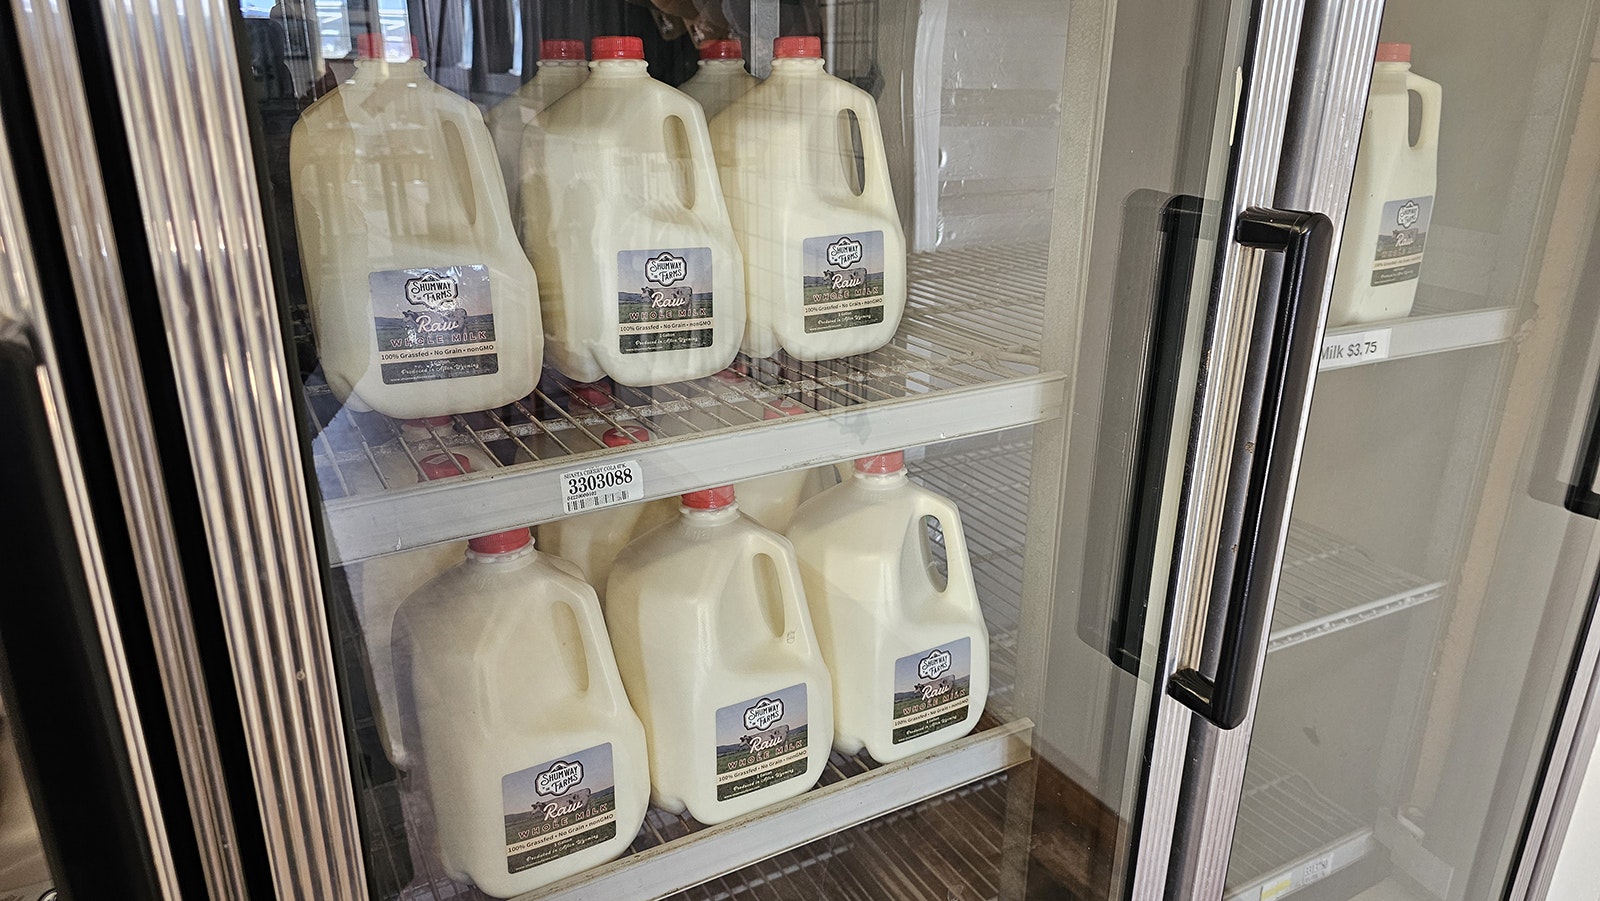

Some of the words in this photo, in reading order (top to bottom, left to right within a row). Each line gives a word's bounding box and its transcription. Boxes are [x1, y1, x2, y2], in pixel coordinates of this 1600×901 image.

[831, 246, 858, 256] SHUMWAY
[838, 252, 858, 264] FARMS
[650, 261, 682, 272] SHUMWAY
[658, 270, 682, 282] FARMS
[832, 274, 860, 289] Raw
[411, 282, 451, 294] SHUMWAY
[813, 291, 850, 301] WHOLE
[854, 286, 878, 296] MILK
[422, 290, 452, 302] FARMS
[651, 292, 686, 308] Raw
[629, 311, 672, 320] WHOLE
[678, 308, 706, 317] MILK
[416, 315, 460, 333] Raw
[452, 331, 488, 343] MILK
[400, 351, 429, 360] Grassfed
[1347, 341, 1377, 357] $3.75
[568, 468, 633, 495] 3303088
[922, 656, 948, 670] SHUMWAY
[929, 662, 948, 675] FARMS
[921, 685, 950, 700] Raw
[903, 699, 938, 715] WHOLE
[942, 689, 966, 703] MILK
[748, 703, 779, 721] SHUMWAY
[757, 711, 779, 727] FARMS
[750, 736, 782, 753] Raw
[728, 751, 770, 769] WHOLE
[776, 740, 802, 754] MILK
[541, 765, 578, 786] SHUMWAY
[551, 774, 578, 792] FARMS
[719, 774, 733, 782] 100%
[544, 802, 584, 821] Raw
[518, 817, 569, 840] WHOLE
[576, 803, 608, 821] MILK
[526, 835, 554, 847] Grassfed
[568, 824, 584, 834] Grain
[588, 814, 614, 826] nonGMO
